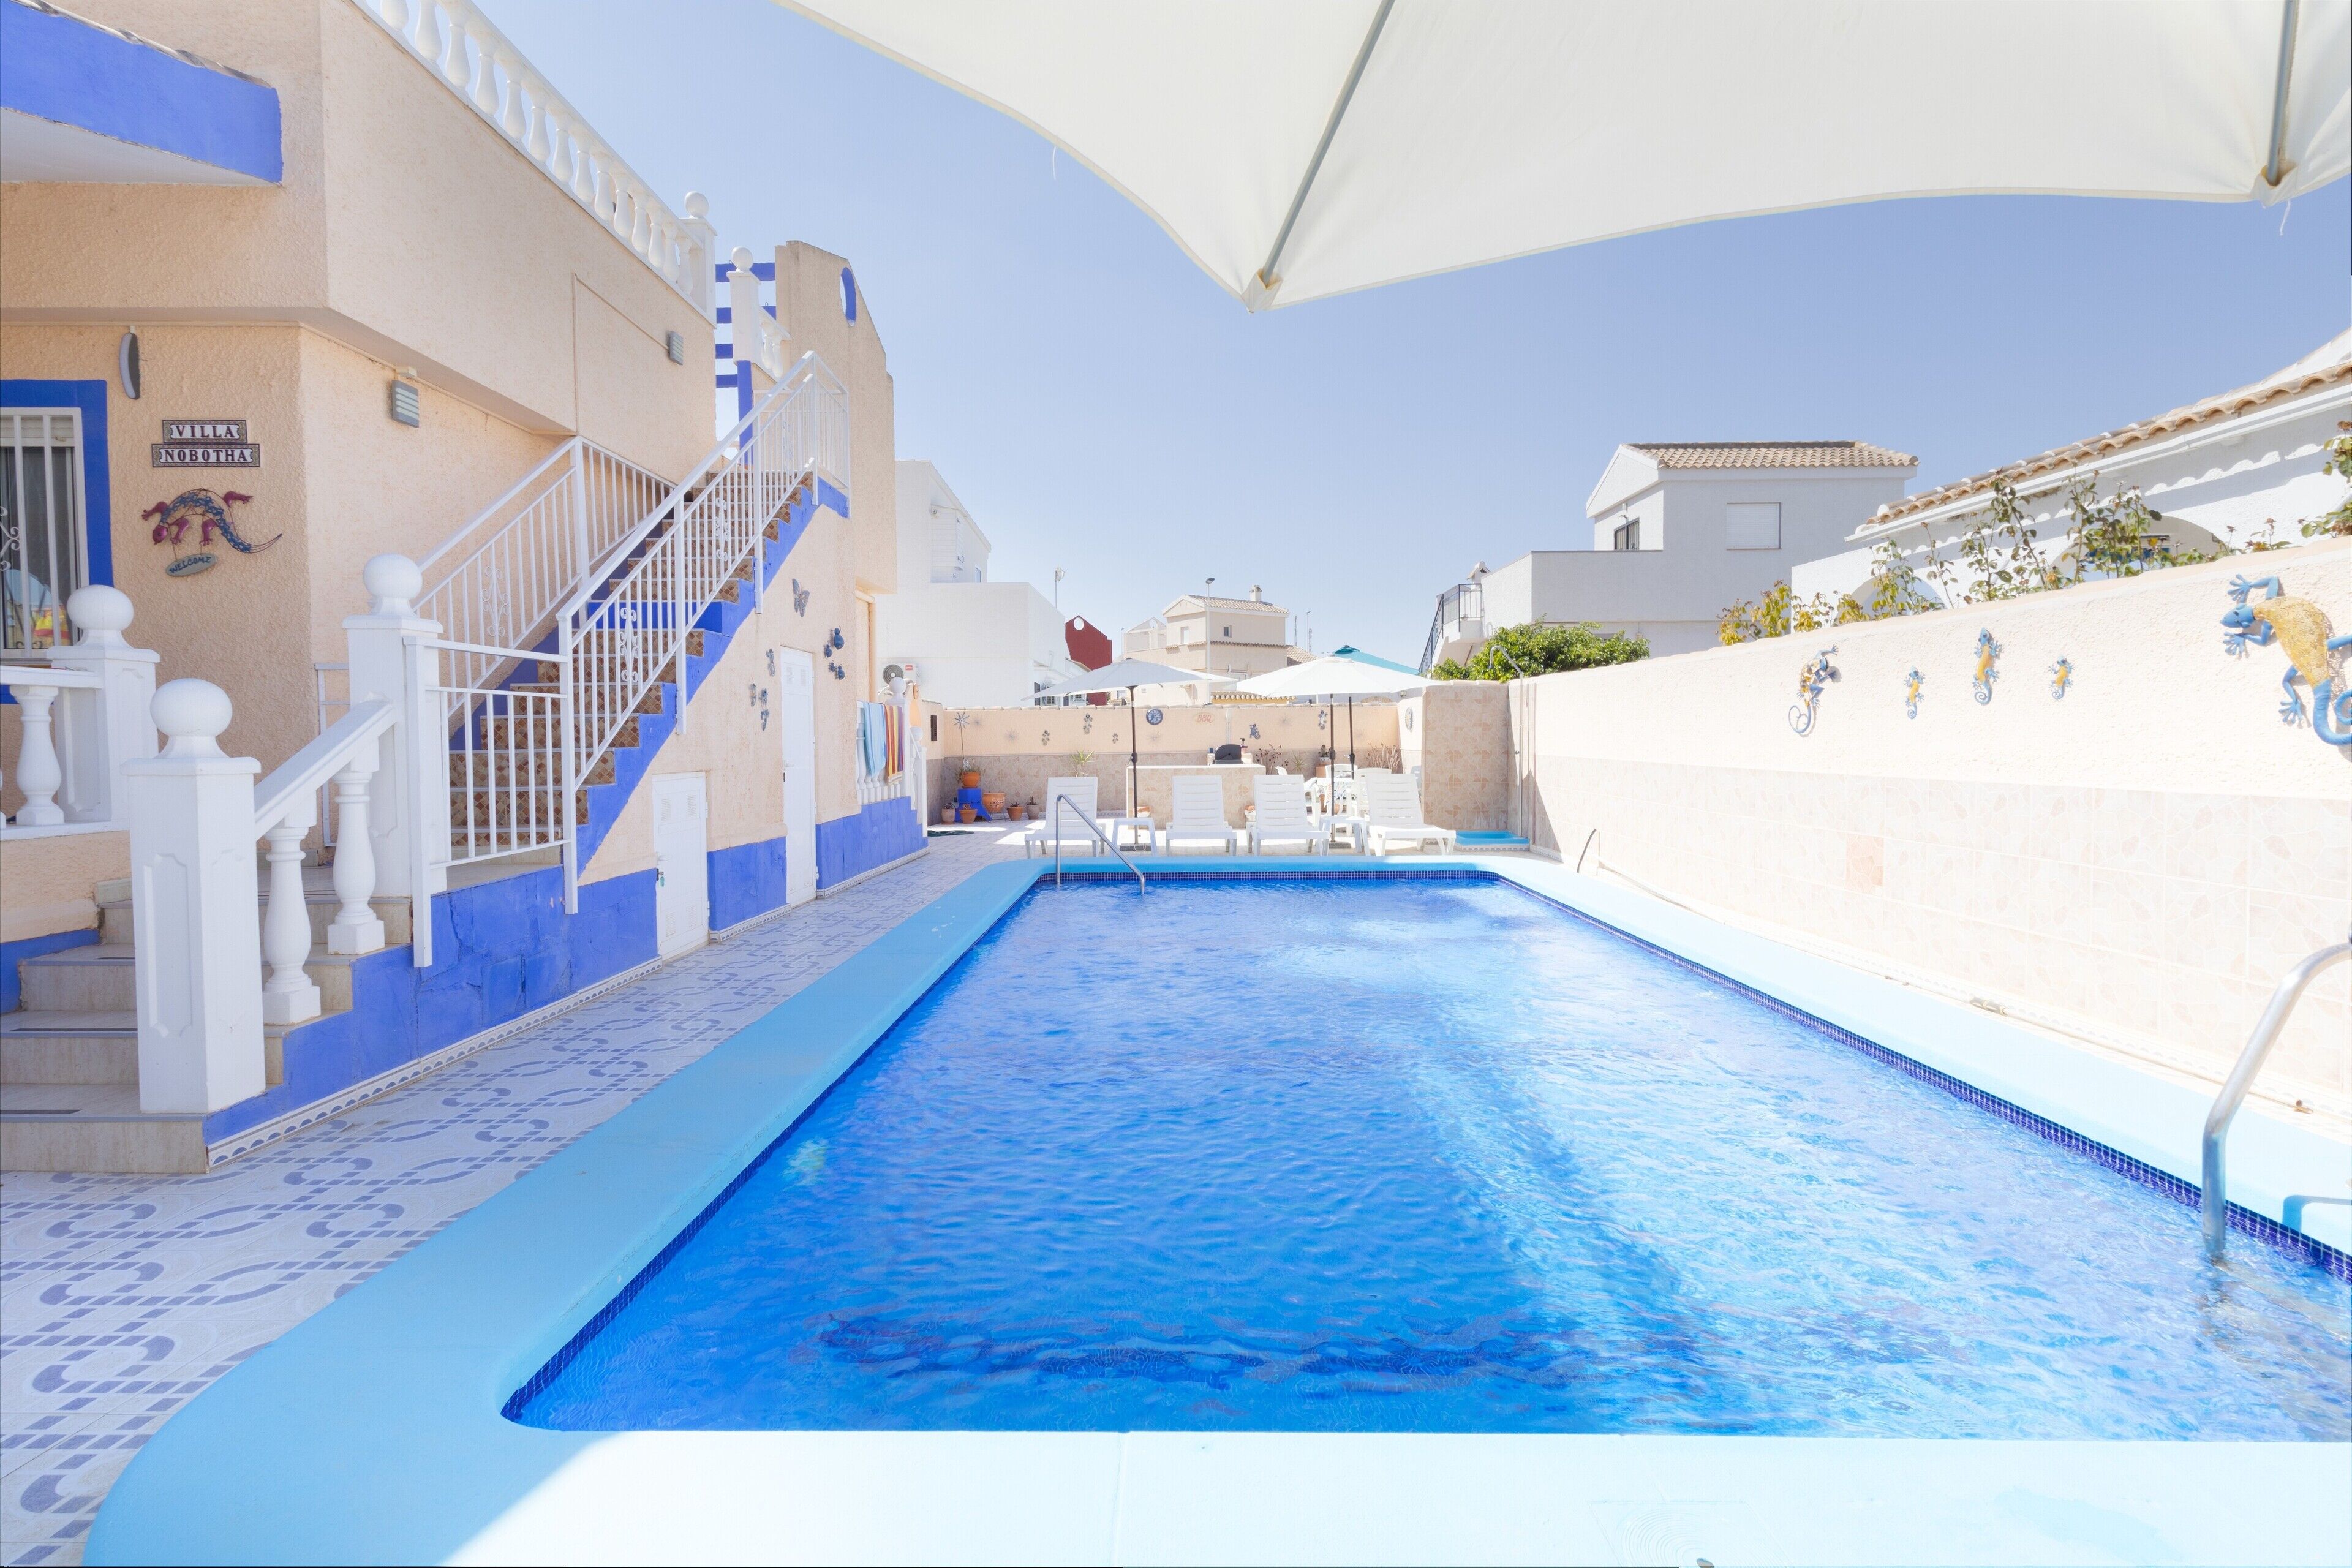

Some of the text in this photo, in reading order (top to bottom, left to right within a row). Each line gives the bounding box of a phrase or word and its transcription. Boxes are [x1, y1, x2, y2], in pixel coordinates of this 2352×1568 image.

[175, 425, 235, 438] VILLA
[164, 450, 248, 462] NOBOTHA
[169, 556, 211, 573] WELCOME
[1197, 714, 1213, 723] BBQ
